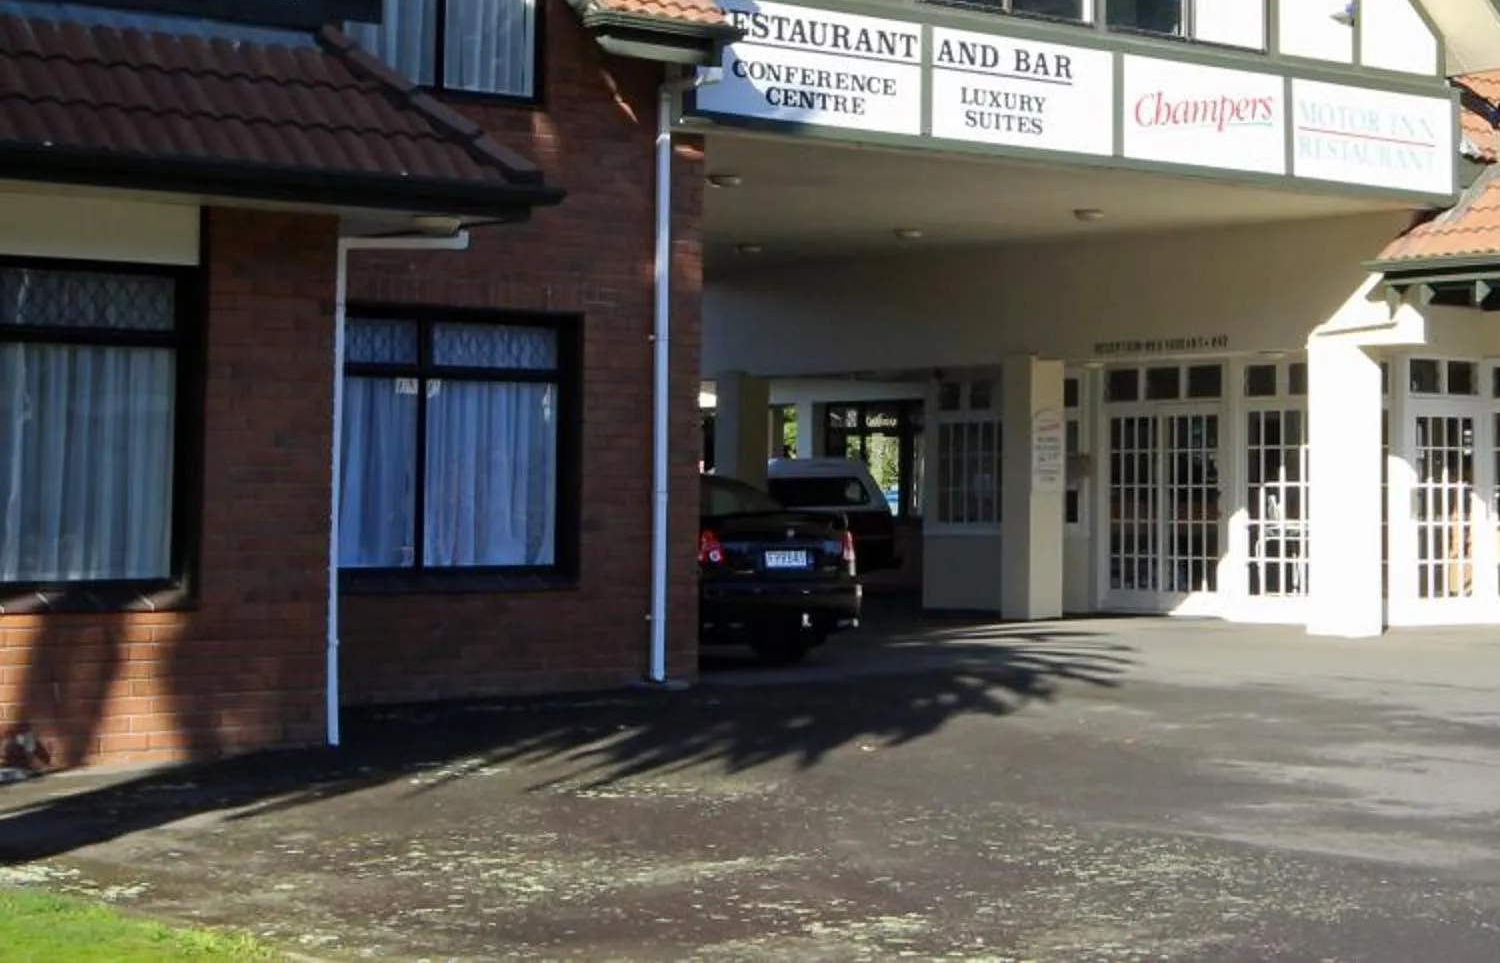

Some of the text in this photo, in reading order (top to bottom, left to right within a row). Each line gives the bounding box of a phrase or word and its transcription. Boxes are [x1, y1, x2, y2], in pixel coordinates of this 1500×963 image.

[729, 9, 1074, 79] ESTAURANT AND BAR
[731, 59, 897, 97] CONFERENCE
[765, 85, 866, 116] CENTRE
[959, 85, 1047, 114] LUXURY
[1134, 91, 1273, 133] Champers
[964, 110, 1044, 136] SUITES
[1299, 100, 1379, 132] MOTOR
